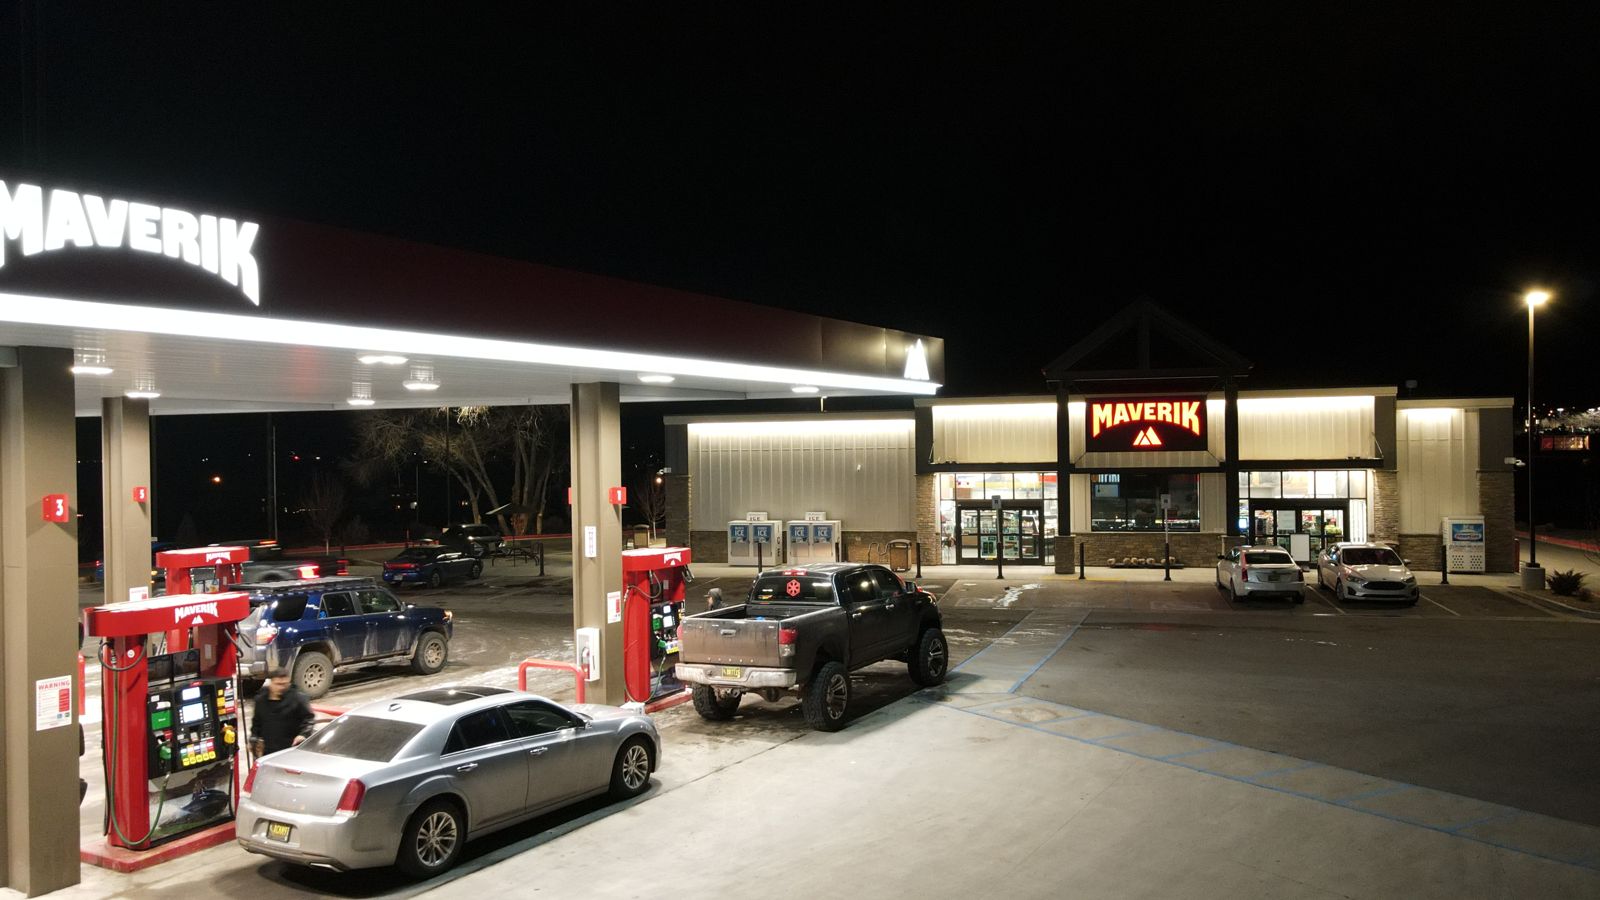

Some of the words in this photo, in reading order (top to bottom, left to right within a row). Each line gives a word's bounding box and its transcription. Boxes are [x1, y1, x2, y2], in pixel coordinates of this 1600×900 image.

[0, 179, 260, 306] MAVERIK
[1092, 401, 1201, 438] MAVERIK
[139, 489, 145, 499] 5
[56, 499, 64, 516] 3
[735, 529, 745, 537] ICE
[757, 529, 768, 537] ICE
[794, 529, 805, 537] ICE
[817, 529, 828, 537] ICE
[174, 602, 219, 624] MAVERIK
[38, 681, 71, 690] WARNING
[225, 680, 232, 690] 3
